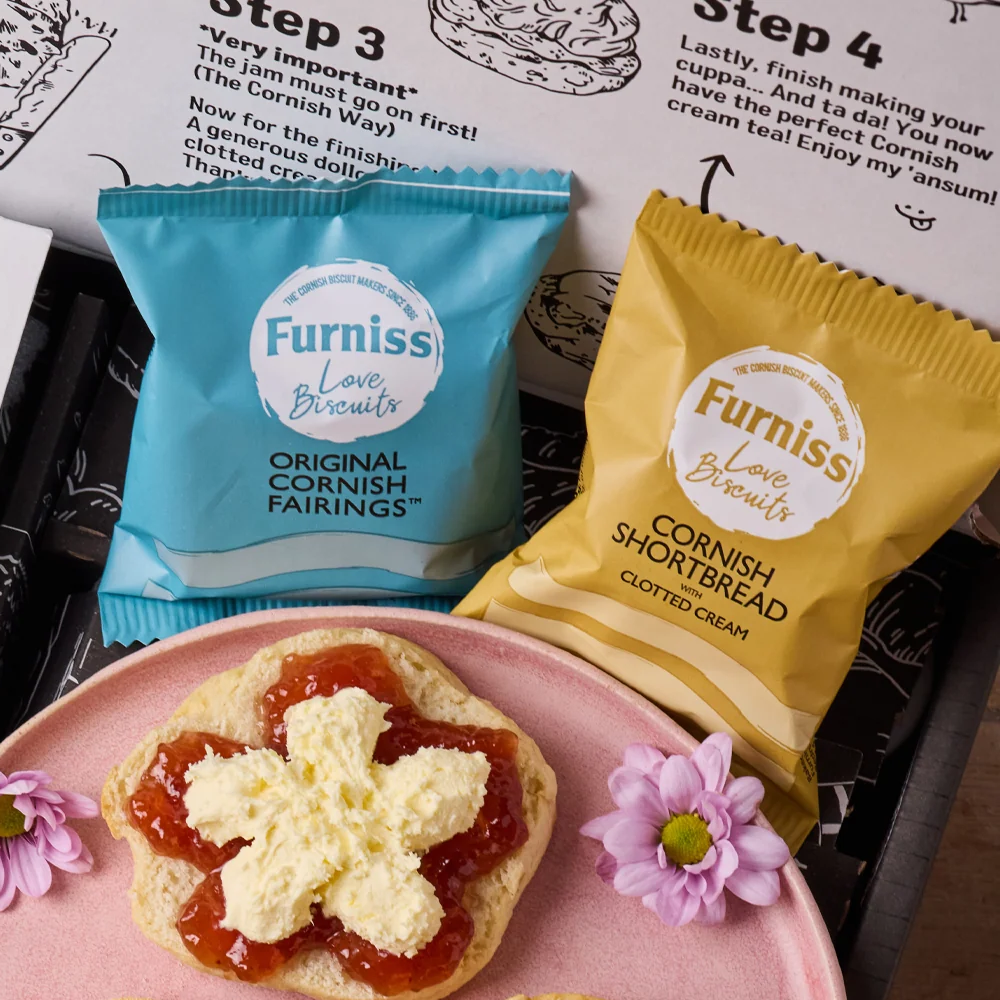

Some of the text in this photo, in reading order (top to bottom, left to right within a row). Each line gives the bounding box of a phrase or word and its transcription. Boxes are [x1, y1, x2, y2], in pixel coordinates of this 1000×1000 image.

[355, 25, 385, 61] 3
[846, 30, 883, 70] 4
[194, 63, 396, 138] (The Cornish Way)
[198, 43, 478, 142] The jam must go on first!
[675, 58, 994, 162] cuppa... And ta da! You now
[680, 34, 986, 138] Lastly, finish making your
[186, 115, 201, 132] A
[207, 123, 308, 164] generous
[190, 95, 236, 122] Now
[242, 111, 277, 134] for
[283, 124, 320, 147] the
[671, 75, 960, 174] have the perfect Cornish
[184, 136, 264, 170] clotted
[667, 98, 998, 206] cream tea! Enjoy my 'ansum!
[282, 290, 300, 306] THE
[298, 277, 328, 297] CORNISH
[328, 273, 357, 285] BISCUIT
[356, 275, 388, 295] MAKERS
[386, 288, 407, 308] SINCE
[266, 314, 432, 358] Furniss
[318, 358, 385, 395] Love
[733, 364, 748, 376] THE
[749, 362, 781, 373] CORNISH
[782, 364, 811, 383] BISCUIT
[806, 377, 834, 405] MAKERS
[289, 383, 403, 420] Biscuits
[694, 377, 852, 483] Furniss
[268, 473, 407, 495] CORNISH
[269, 451, 407, 473] ORIGINAL
[724, 440, 791, 489] Love
[685, 452, 795, 522] Biscuits
[612, 522, 788, 622] SHORTBREAD
[652, 514, 775, 588] CORNISH
[620, 570, 749, 641] CLOTTED CREAM
[680, 583, 703, 600] WITH
